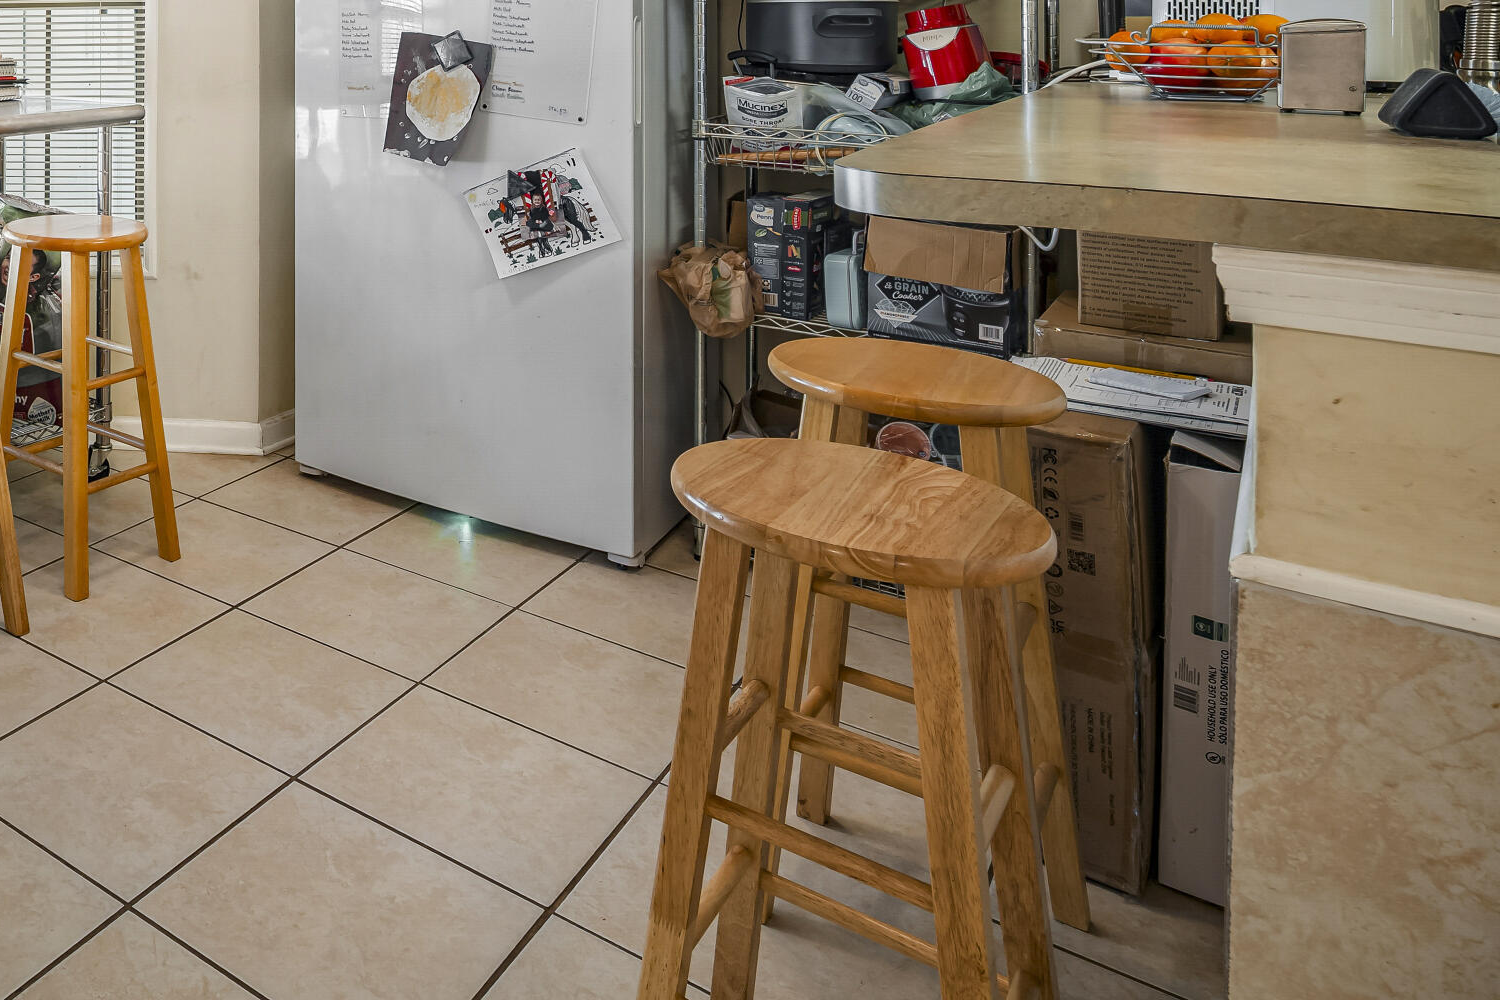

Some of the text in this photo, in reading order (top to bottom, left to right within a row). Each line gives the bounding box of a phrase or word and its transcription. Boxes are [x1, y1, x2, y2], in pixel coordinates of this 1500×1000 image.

[741, 115, 785, 126] SORE THROAT
[894, 281, 929, 295] GRAIN
[892, 292, 924, 301] Cooker
[28, 407, 55, 420] Mother's
[1220, 649, 1229, 691] DOMÉSTICO
[1207, 665, 1217, 743] HOUSEHOLD USE ONLY
[1220, 691, 1228, 706] USO
[1220, 707, 1228, 725] PARA
